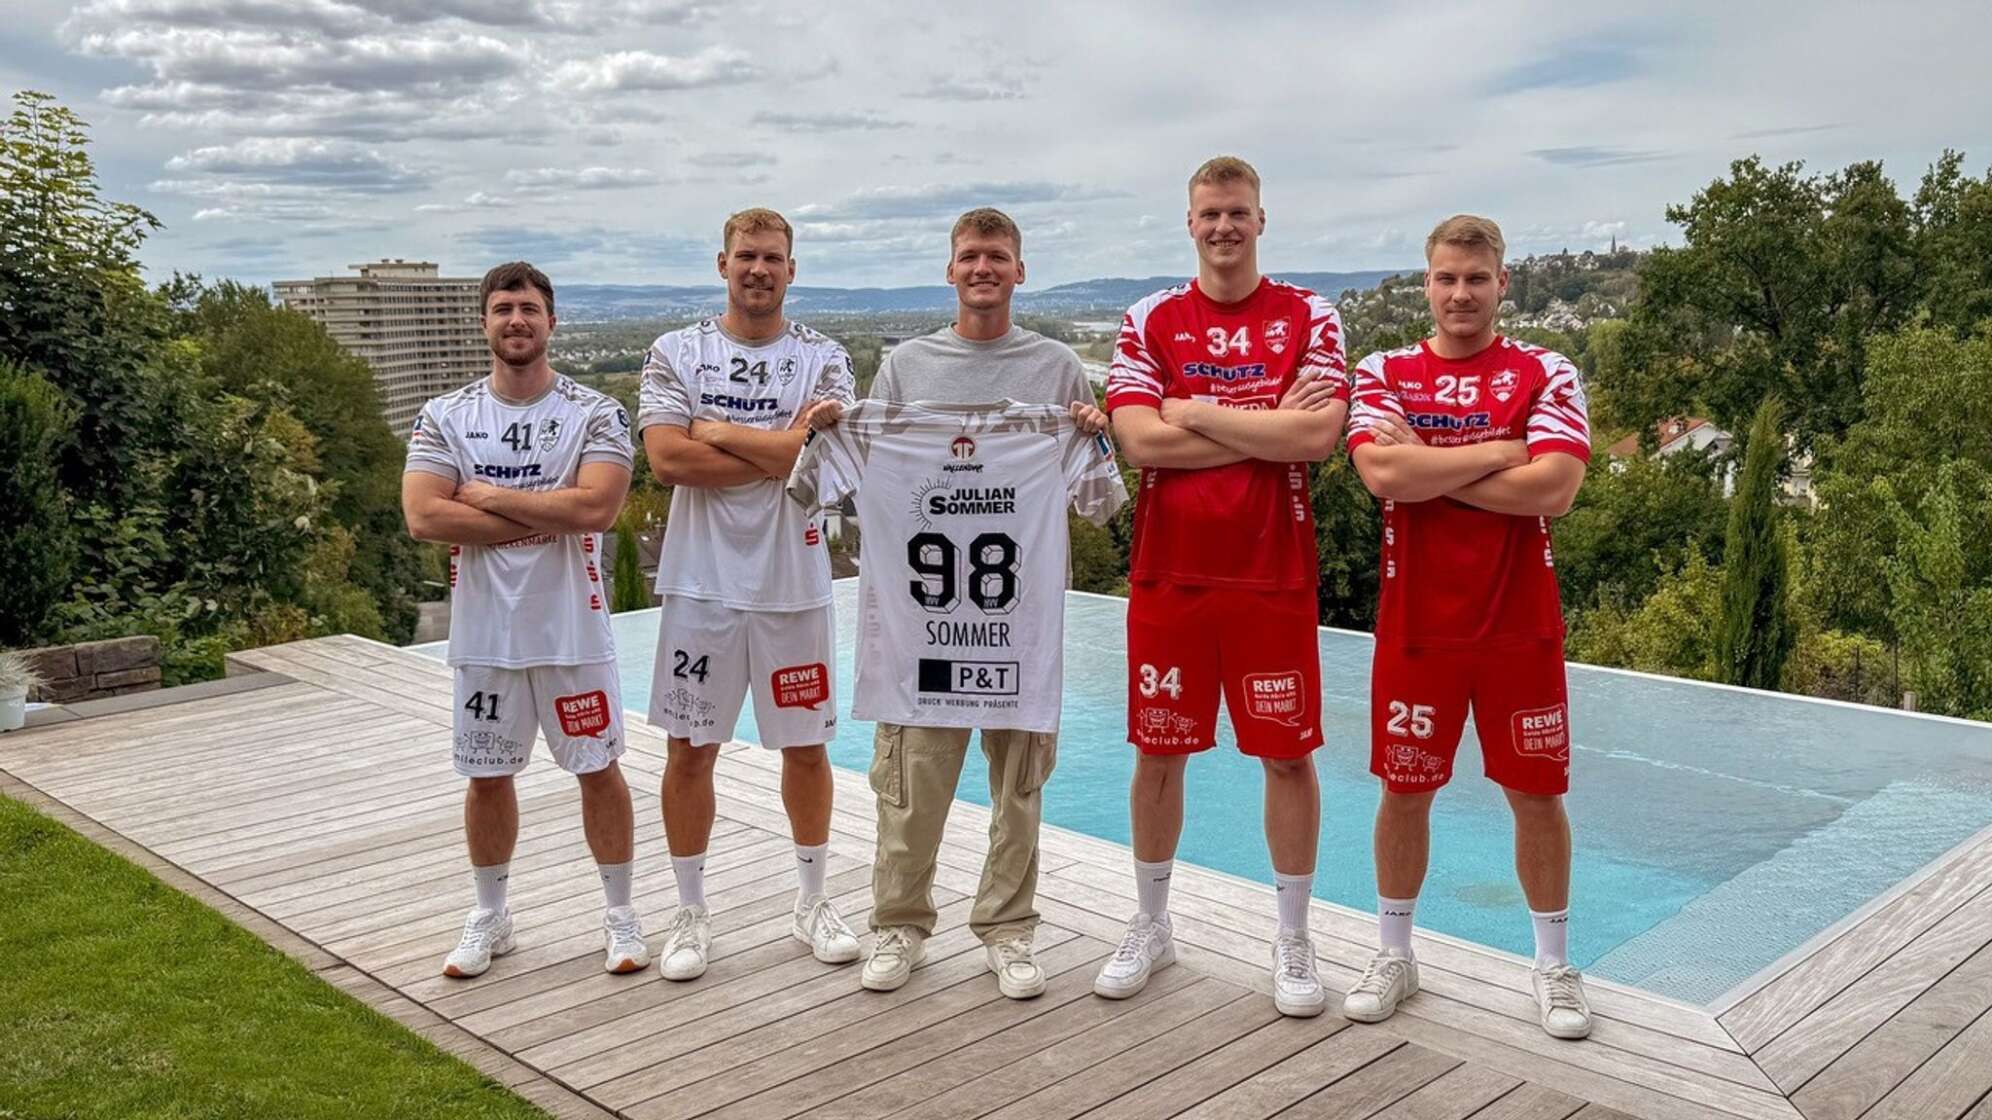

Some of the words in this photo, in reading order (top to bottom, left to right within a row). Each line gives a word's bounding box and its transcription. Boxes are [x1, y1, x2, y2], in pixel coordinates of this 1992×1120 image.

[1206, 326, 1252, 357] 34
[729, 357, 770, 384] 24
[1434, 375, 1481, 406] 25
[465, 432, 488, 440] JAKO
[501, 422, 532, 451] 41
[950, 487, 1015, 501] JULIAN
[907, 532, 1022, 616] 98
[926, 620, 1011, 647] SOMMER
[673, 649, 711, 683] 24
[779, 667, 820, 685] REWE
[960, 667, 1009, 689] P&T
[781, 691, 798, 703] DEIN
[799, 686, 821, 700] MARKT
[1139, 663, 1183, 700] 34
[1253, 677, 1296, 692] REWE
[465, 691, 499, 721] 41
[562, 695, 600, 713] REWE
[918, 697, 941, 706] DRUCK
[945, 699, 979, 708] WERBUNG
[1387, 700, 1435, 739] 25
[1522, 710, 1562, 729] REWE
